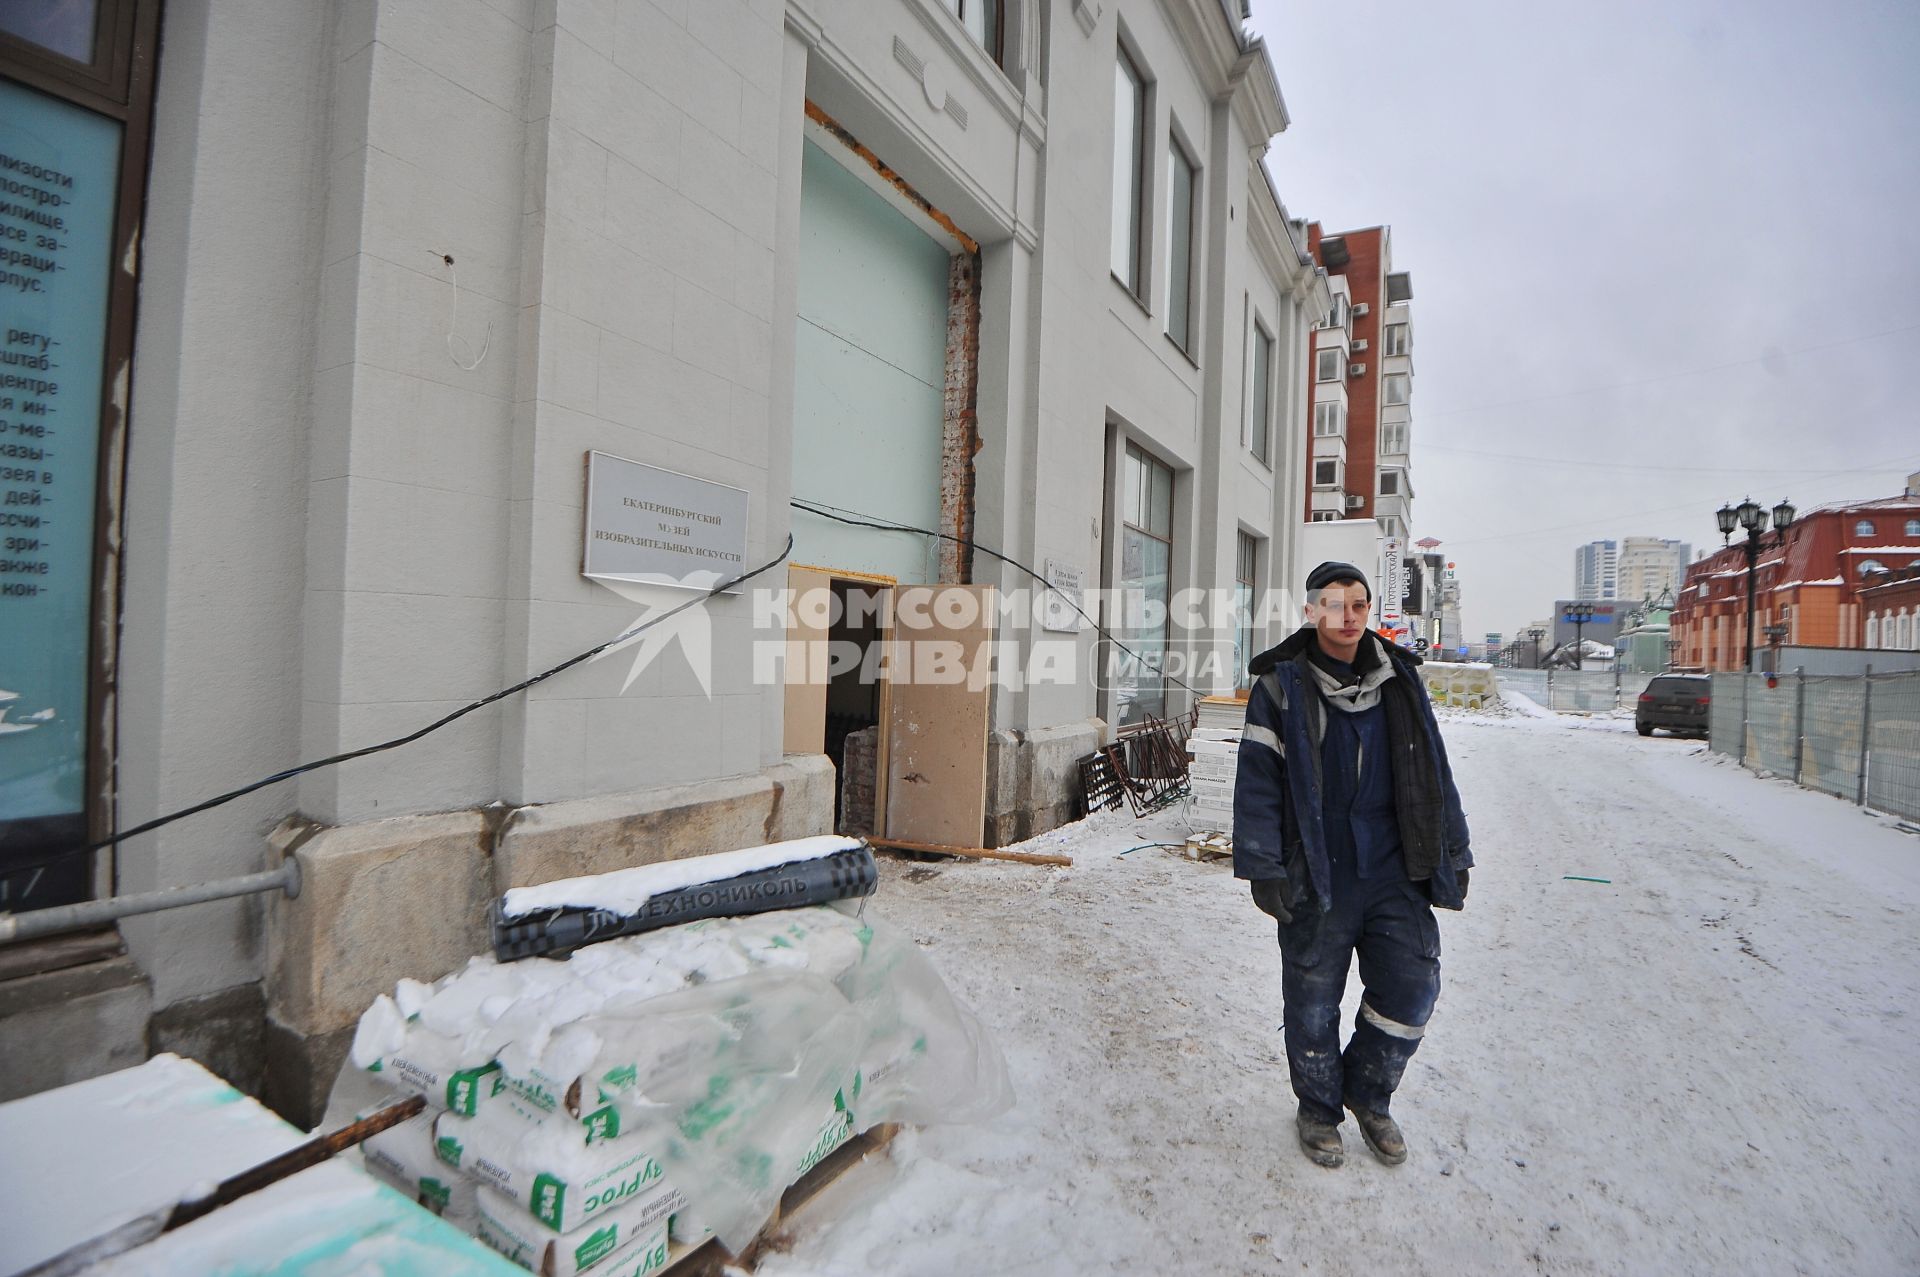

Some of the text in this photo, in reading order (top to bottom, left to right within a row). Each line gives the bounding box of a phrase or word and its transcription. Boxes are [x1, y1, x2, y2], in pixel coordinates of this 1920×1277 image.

[35, 234, 68, 251] за-
[7, 328, 61, 351] регу-
[0, 350, 60, 371] штаб-
[23, 400, 57, 415] ин-
[0, 466, 54, 484] зея в
[4, 488, 53, 506] дей-
[623, 497, 722, 526] ЕКАТЕРИНБУРГСКИЙ
[657, 522, 690, 537] МУЗЕЙ
[5, 535, 51, 553] зри-
[595, 530, 742, 563] ИЗОБРАЗИТЕЛЬНЫХ ИСКУССТВ
[2, 582, 48, 596] кон-
[1402, 566, 1411, 598] UPPER
